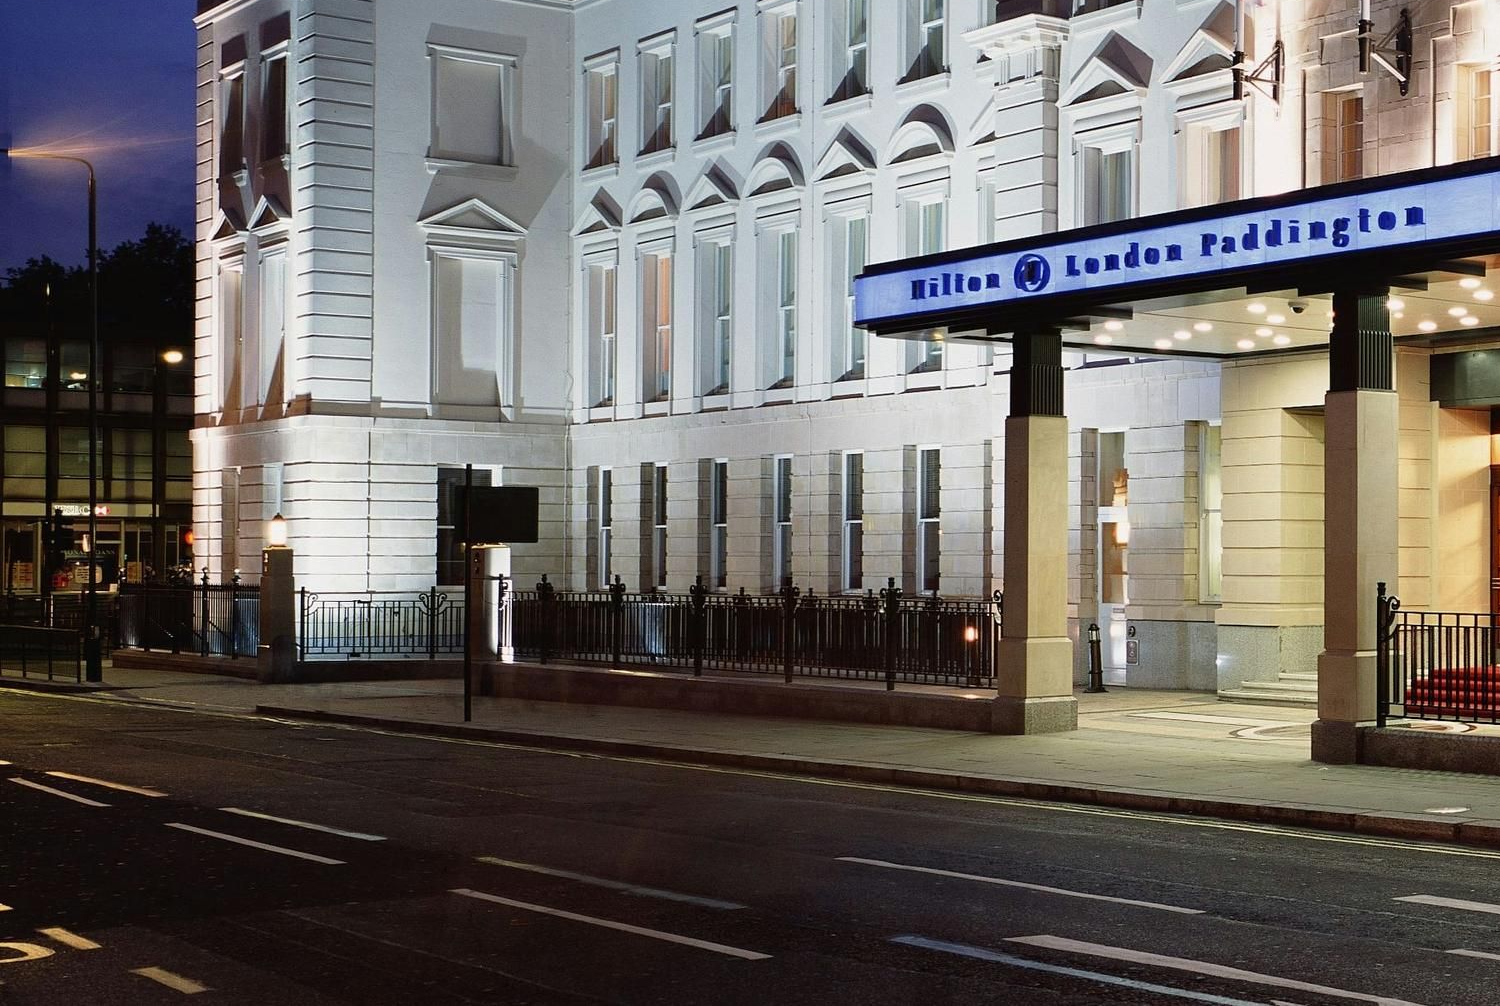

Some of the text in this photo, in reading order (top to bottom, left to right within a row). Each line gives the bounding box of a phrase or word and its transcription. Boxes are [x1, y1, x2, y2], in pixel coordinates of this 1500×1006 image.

[911, 206, 1427, 300] Hilton London Paddington
